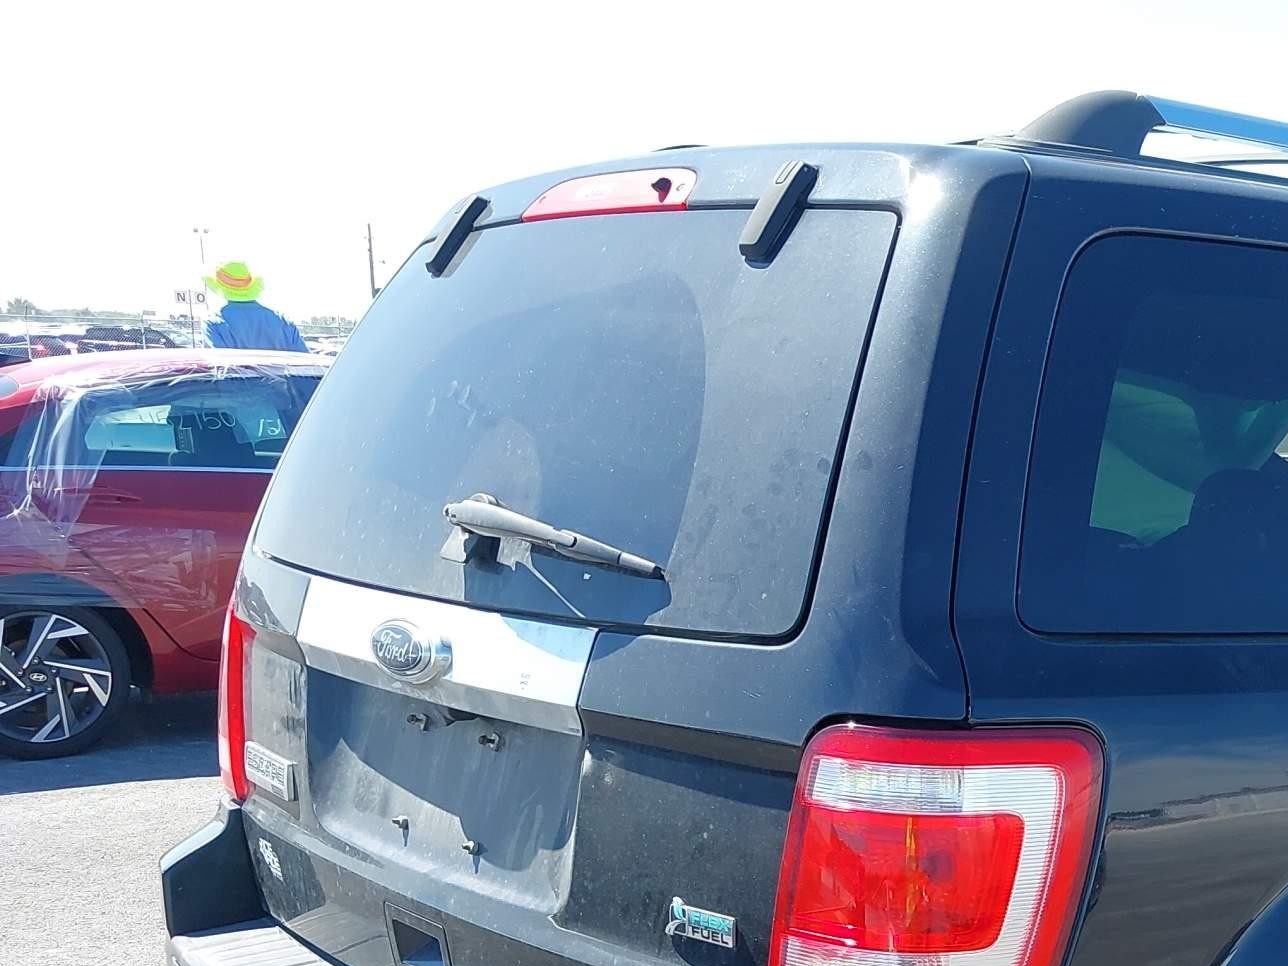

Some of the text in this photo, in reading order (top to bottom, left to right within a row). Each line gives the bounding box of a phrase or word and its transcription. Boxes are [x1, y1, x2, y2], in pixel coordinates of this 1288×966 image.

[377, 629, 418, 663] Ford
[691, 911, 729, 932] FLEX
[691, 926, 729, 945] FUEL
